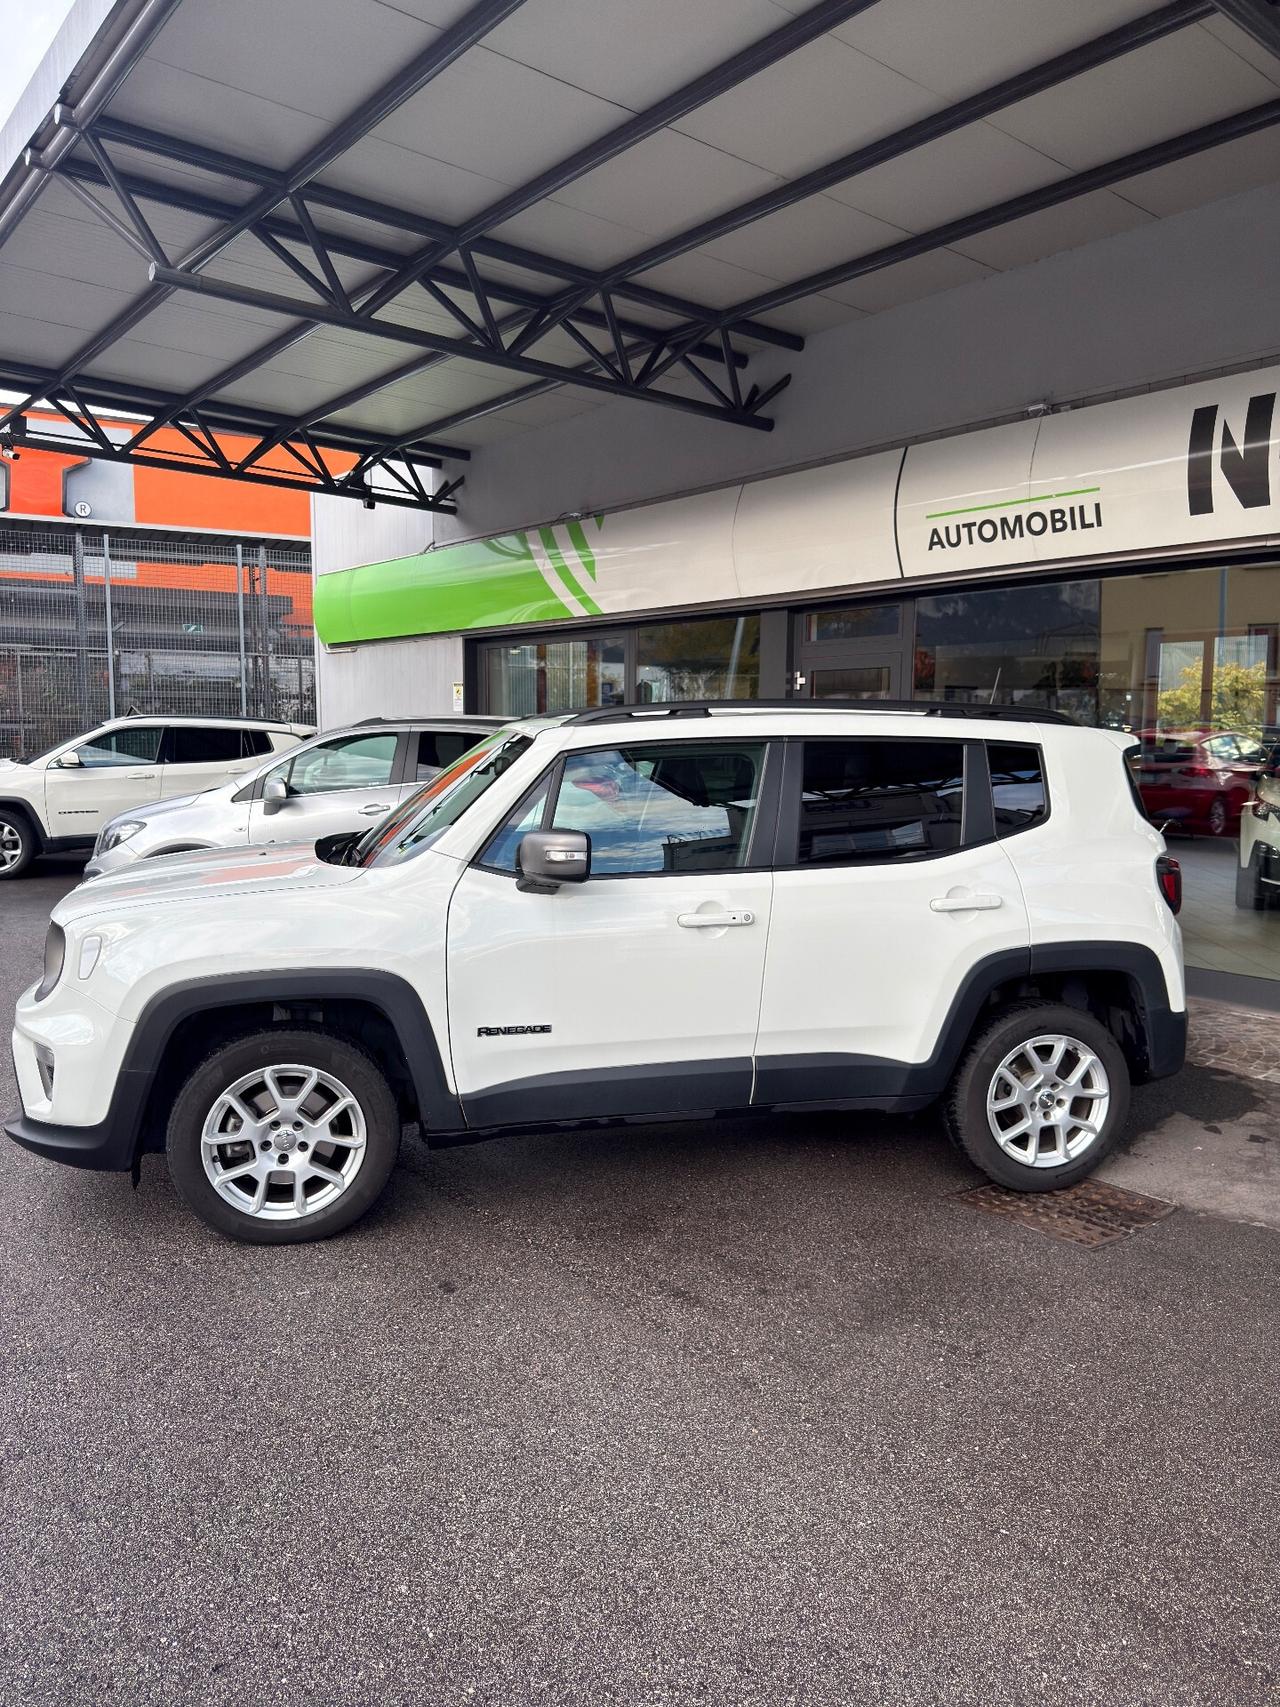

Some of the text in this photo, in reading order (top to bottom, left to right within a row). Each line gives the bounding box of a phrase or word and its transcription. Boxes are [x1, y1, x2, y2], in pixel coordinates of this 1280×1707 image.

[1187, 392, 1280, 516] N
[928, 502, 1103, 551] AUTOMOBILI
[477, 1024, 553, 1038] RENEGADE
